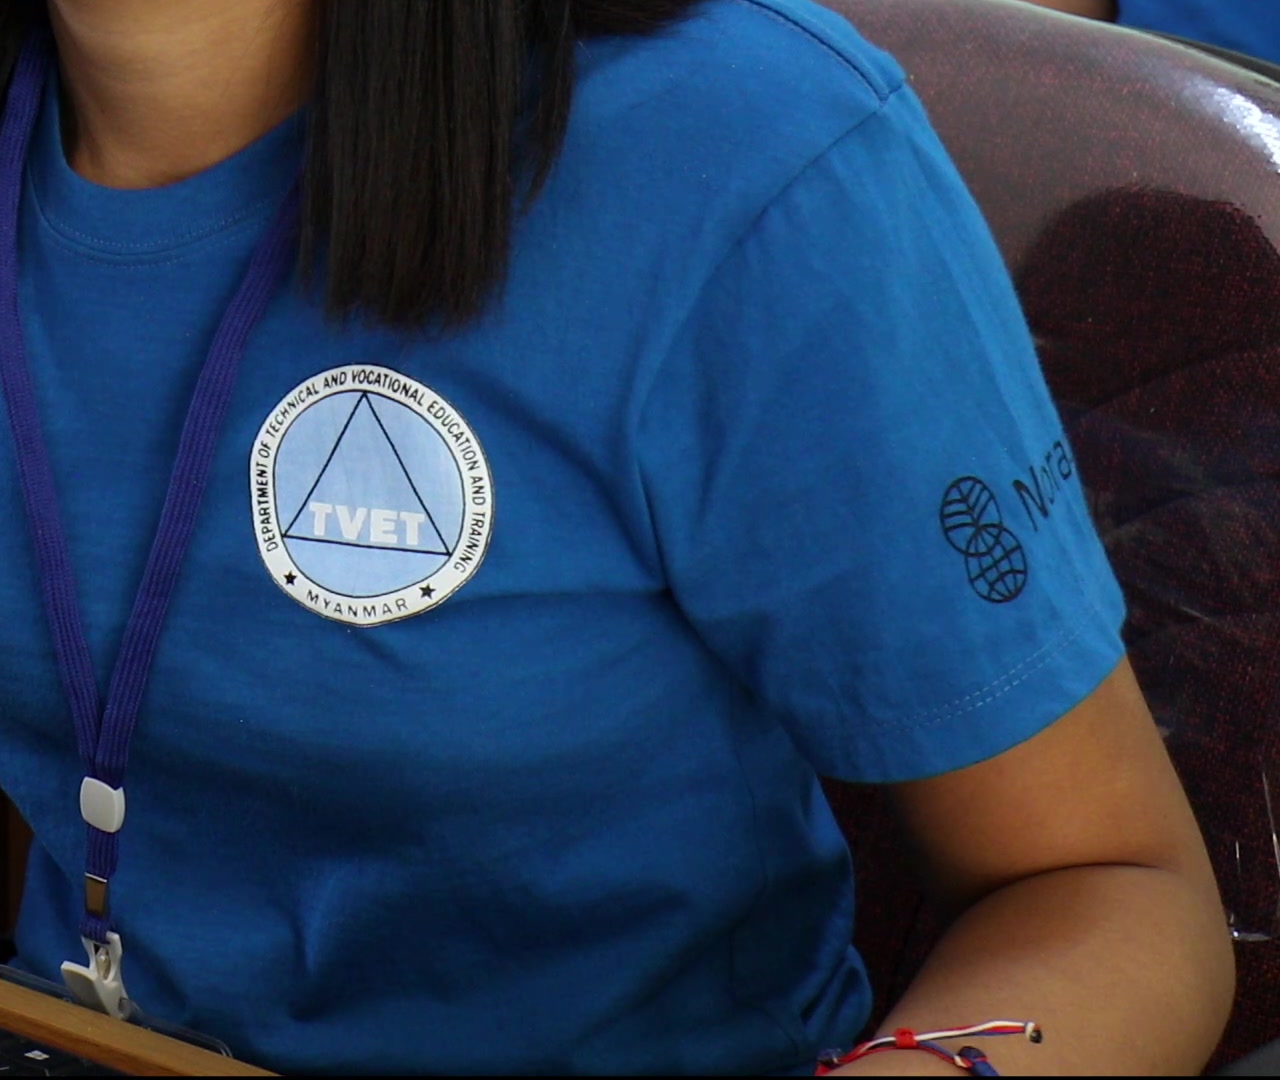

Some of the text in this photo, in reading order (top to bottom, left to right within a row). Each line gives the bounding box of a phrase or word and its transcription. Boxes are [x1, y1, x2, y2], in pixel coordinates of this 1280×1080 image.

[256, 368, 487, 574] DEPARTMENT OF TECHNICAL AND VOCATIONAL EDUCATION AND TRAINING
[308, 501, 426, 547] TVET
[306, 588, 409, 618] MYANMAR
